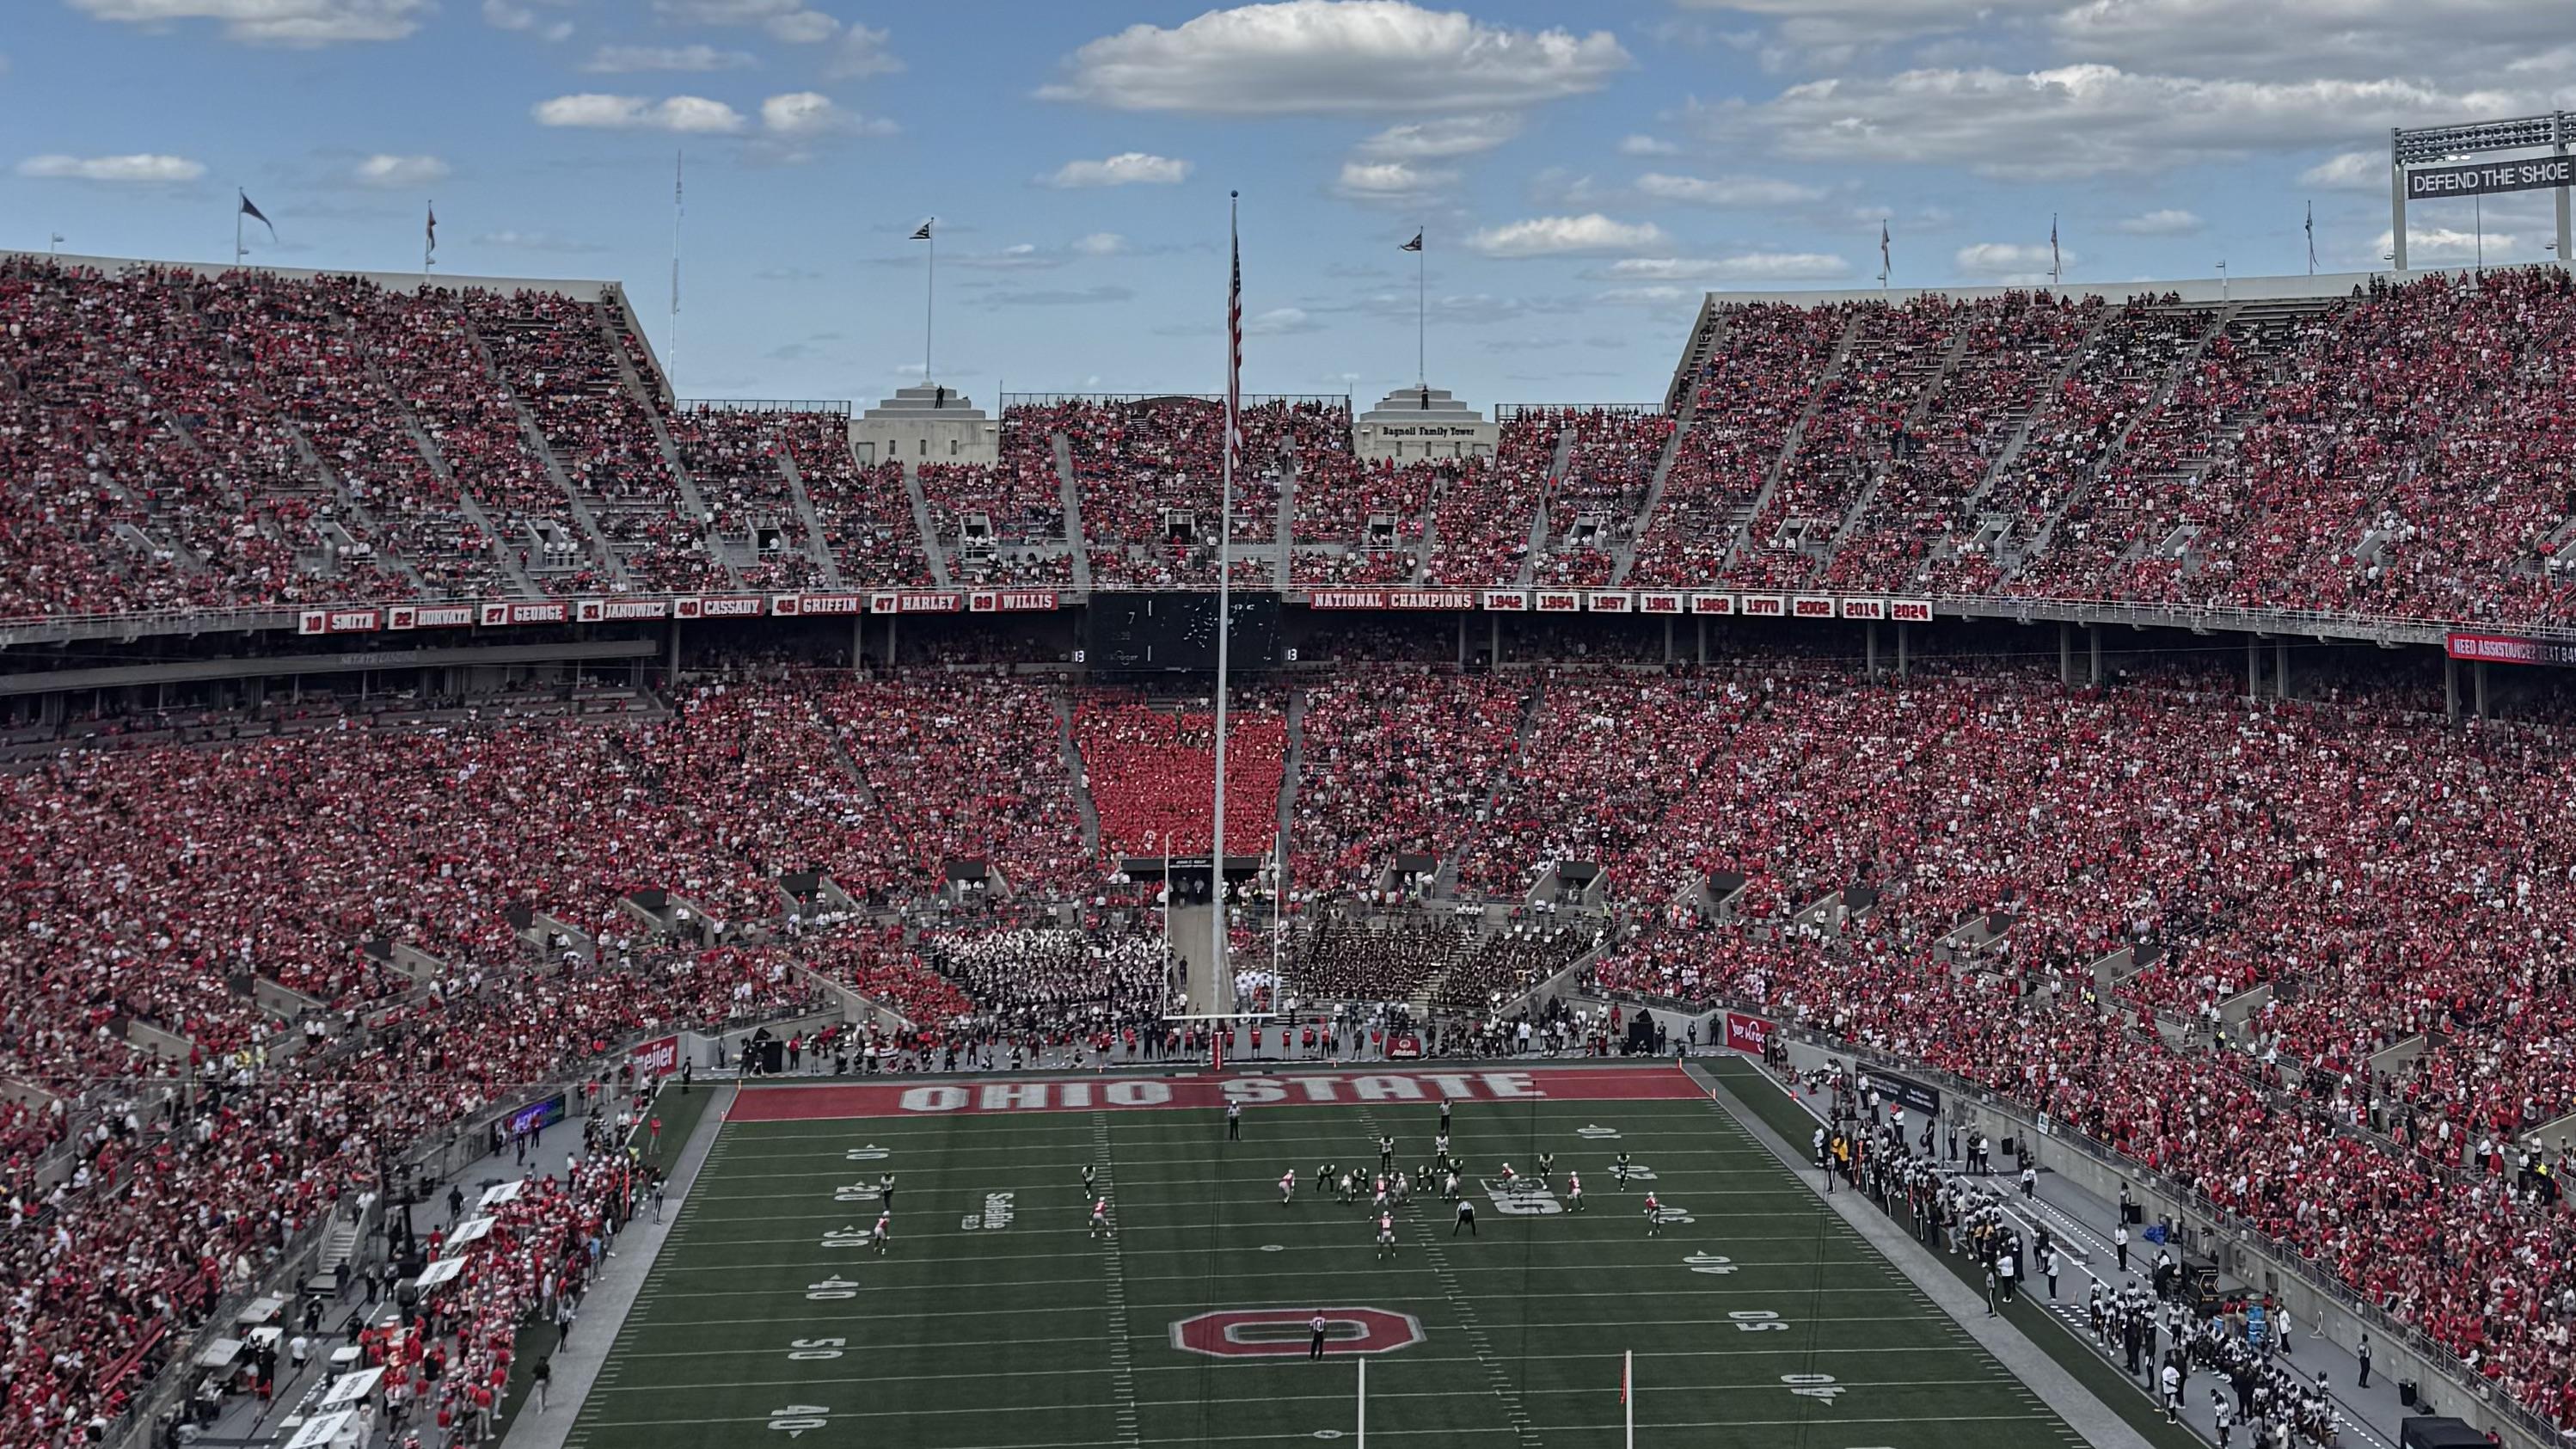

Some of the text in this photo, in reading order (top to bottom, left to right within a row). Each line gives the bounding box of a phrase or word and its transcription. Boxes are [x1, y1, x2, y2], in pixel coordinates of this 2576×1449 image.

[2413, 163, 2570, 193] DEFEND THE 'SHOE
[1419, 427, 1447, 438] Family
[1451, 427, 1475, 436] Tower
[678, 599, 760, 616] 40 CASSADY
[776, 598, 858, 614] 45 GRIFFIN
[875, 595, 956, 611] 47 HARLEY
[1003, 594, 1053, 609] WILLIS
[1315, 592, 1472, 608] NATIONAL CHAMPIONS
[1488, 594, 1522, 608] 1942
[1541, 596, 1574, 609] 1954
[1593, 597, 1626, 610] 1957
[1747, 599, 1780, 613] 1970
[1796, 600, 1831, 615] 2002
[486, 605, 563, 623] 27 GEORGE
[582, 602, 666, 620] 31 JANOWICZ
[1846, 602, 1880, 617] 2014
[1893, 604, 1928, 619] 2024
[332, 613, 374, 629] SMITH
[394, 611, 412, 627] 22
[2454, 638, 2476, 655] NEED
[899, 1072, 1553, 1111] OHIO STATE
[1728, 1311, 1789, 1331] 50
[788, 1338, 846, 1360] 50
